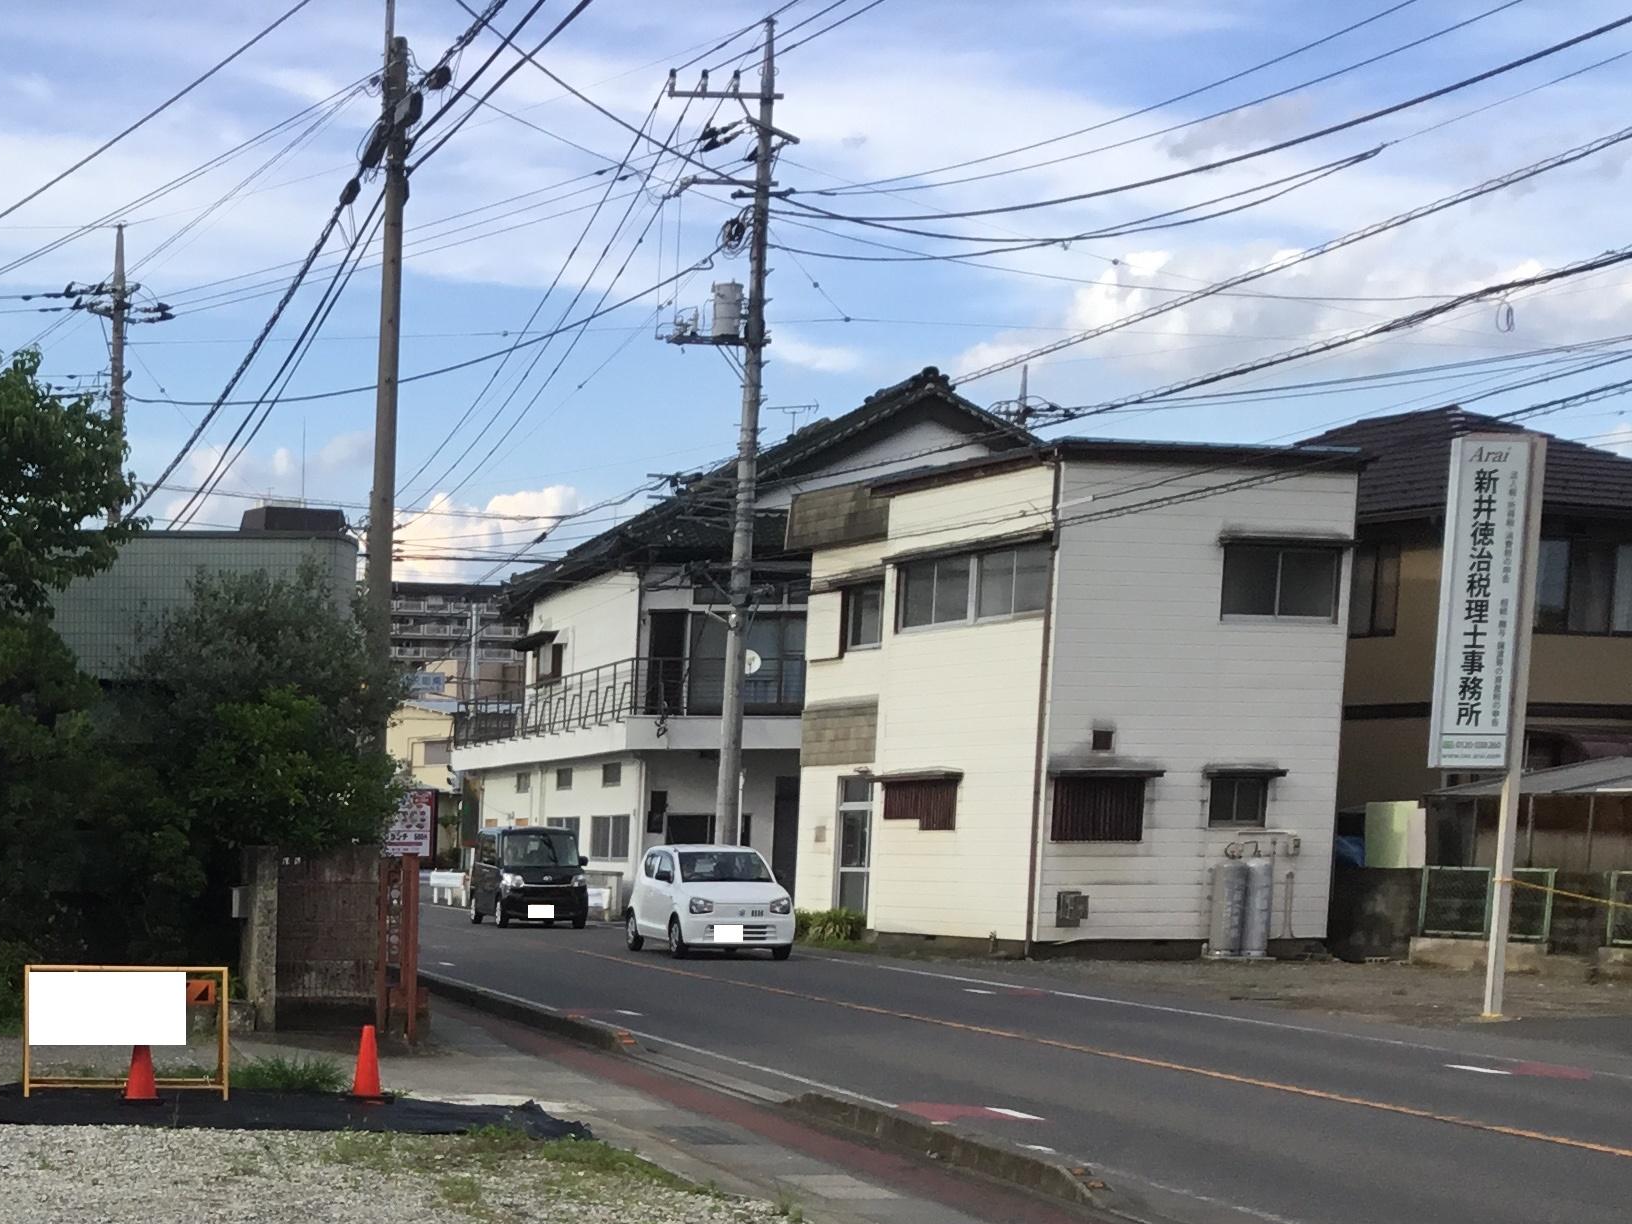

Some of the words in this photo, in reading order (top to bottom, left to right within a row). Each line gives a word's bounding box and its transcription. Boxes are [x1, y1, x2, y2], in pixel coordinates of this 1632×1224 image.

[1468, 446, 1511, 463] Arai
[1456, 468, 1500, 728] 新井徳治税理士事務所
